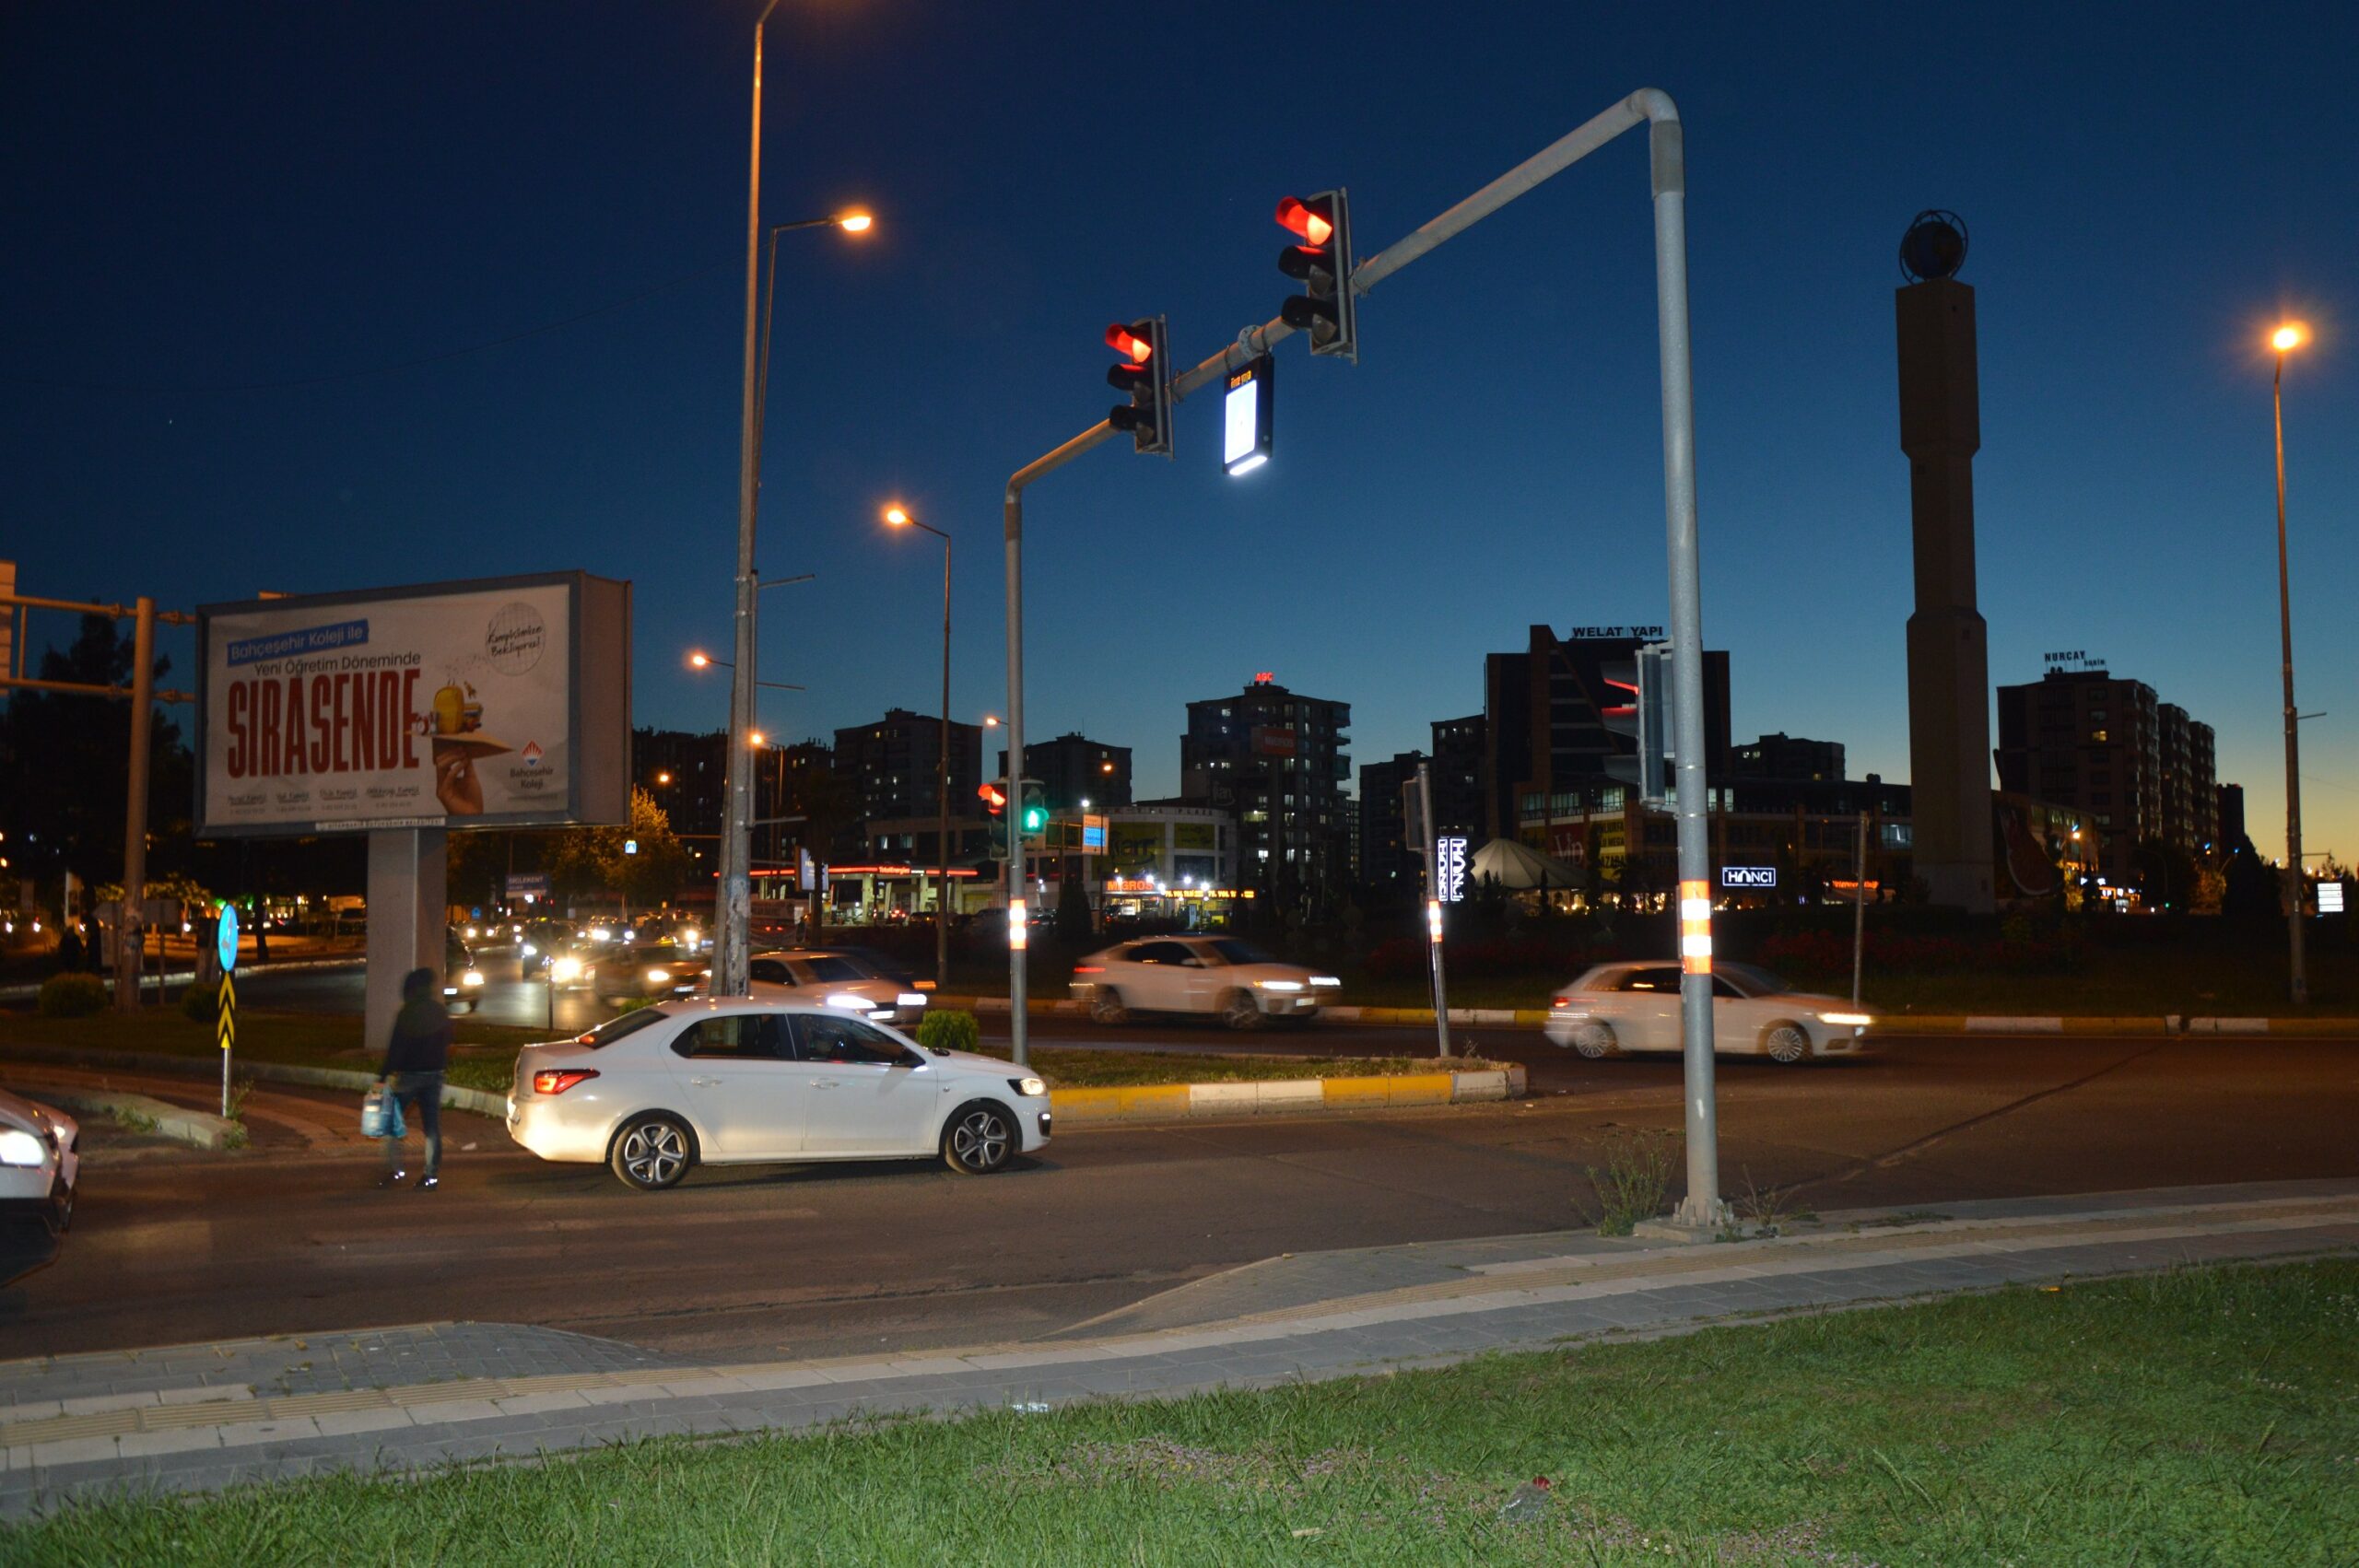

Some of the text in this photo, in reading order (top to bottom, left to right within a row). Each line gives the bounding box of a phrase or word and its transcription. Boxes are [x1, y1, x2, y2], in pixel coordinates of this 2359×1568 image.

[1572, 626, 1663, 637] WELAT YAPI
[230, 626, 363, 661] Bahçeşehir Koleji ile
[254, 649, 422, 677] Yeni Öğretim Döneminde
[510, 766, 554, 778] Bahçeşehir
[521, 778, 544, 790] Koleji
